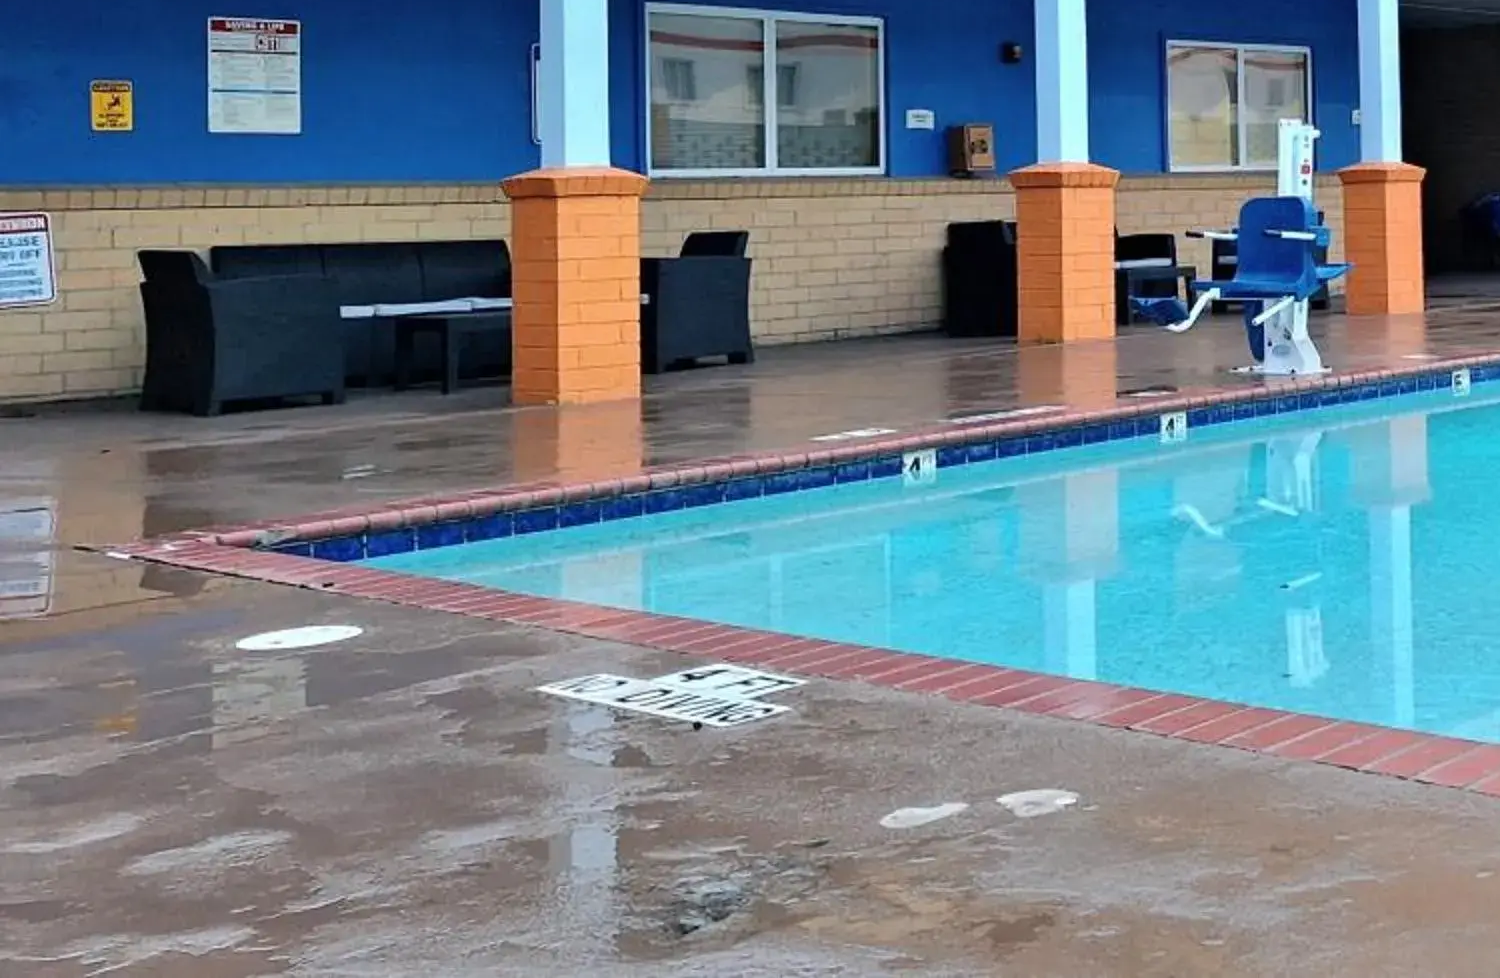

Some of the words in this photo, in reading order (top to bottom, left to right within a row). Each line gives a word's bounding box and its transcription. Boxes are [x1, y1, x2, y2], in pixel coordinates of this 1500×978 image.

[544, 674, 628, 694] NO
[615, 687, 774, 723] DIVING
[680, 668, 730, 683] 4
[715, 675, 798, 696] FT
